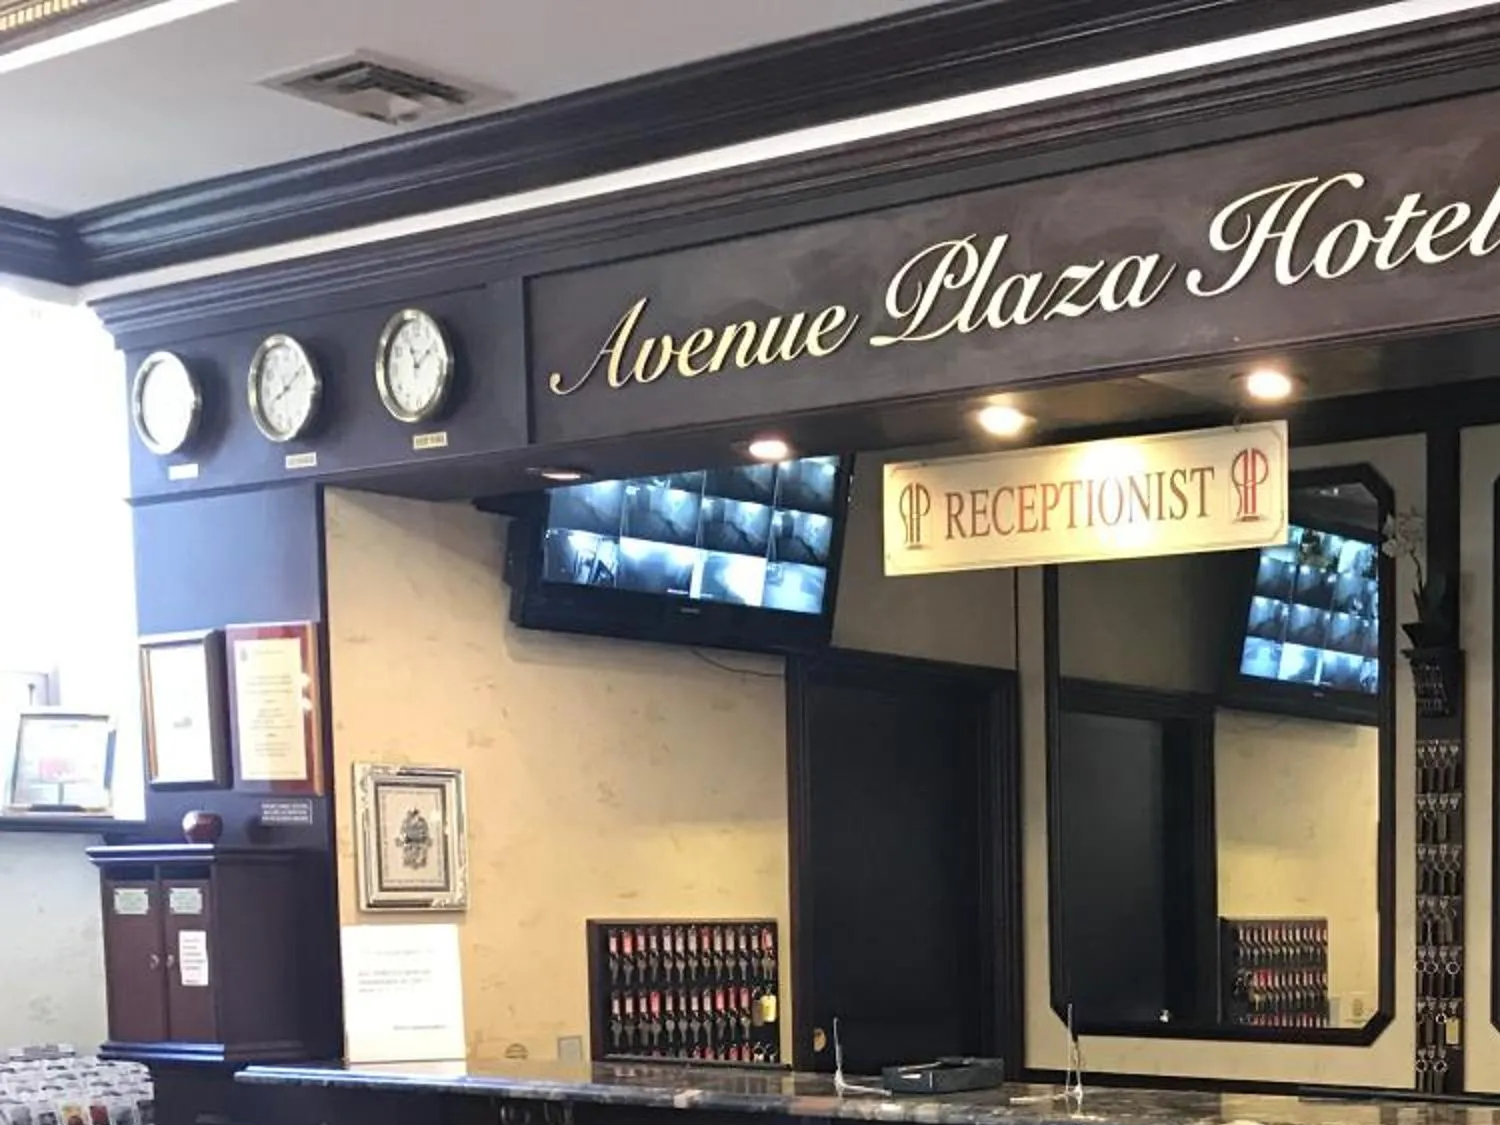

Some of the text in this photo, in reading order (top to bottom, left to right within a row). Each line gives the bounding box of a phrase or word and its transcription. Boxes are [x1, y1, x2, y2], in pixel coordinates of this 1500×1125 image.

[548, 297, 860, 396] Avenue
[868, 232, 1177, 347] Plaza
[944, 466, 1215, 541] RECEPTIONIST
